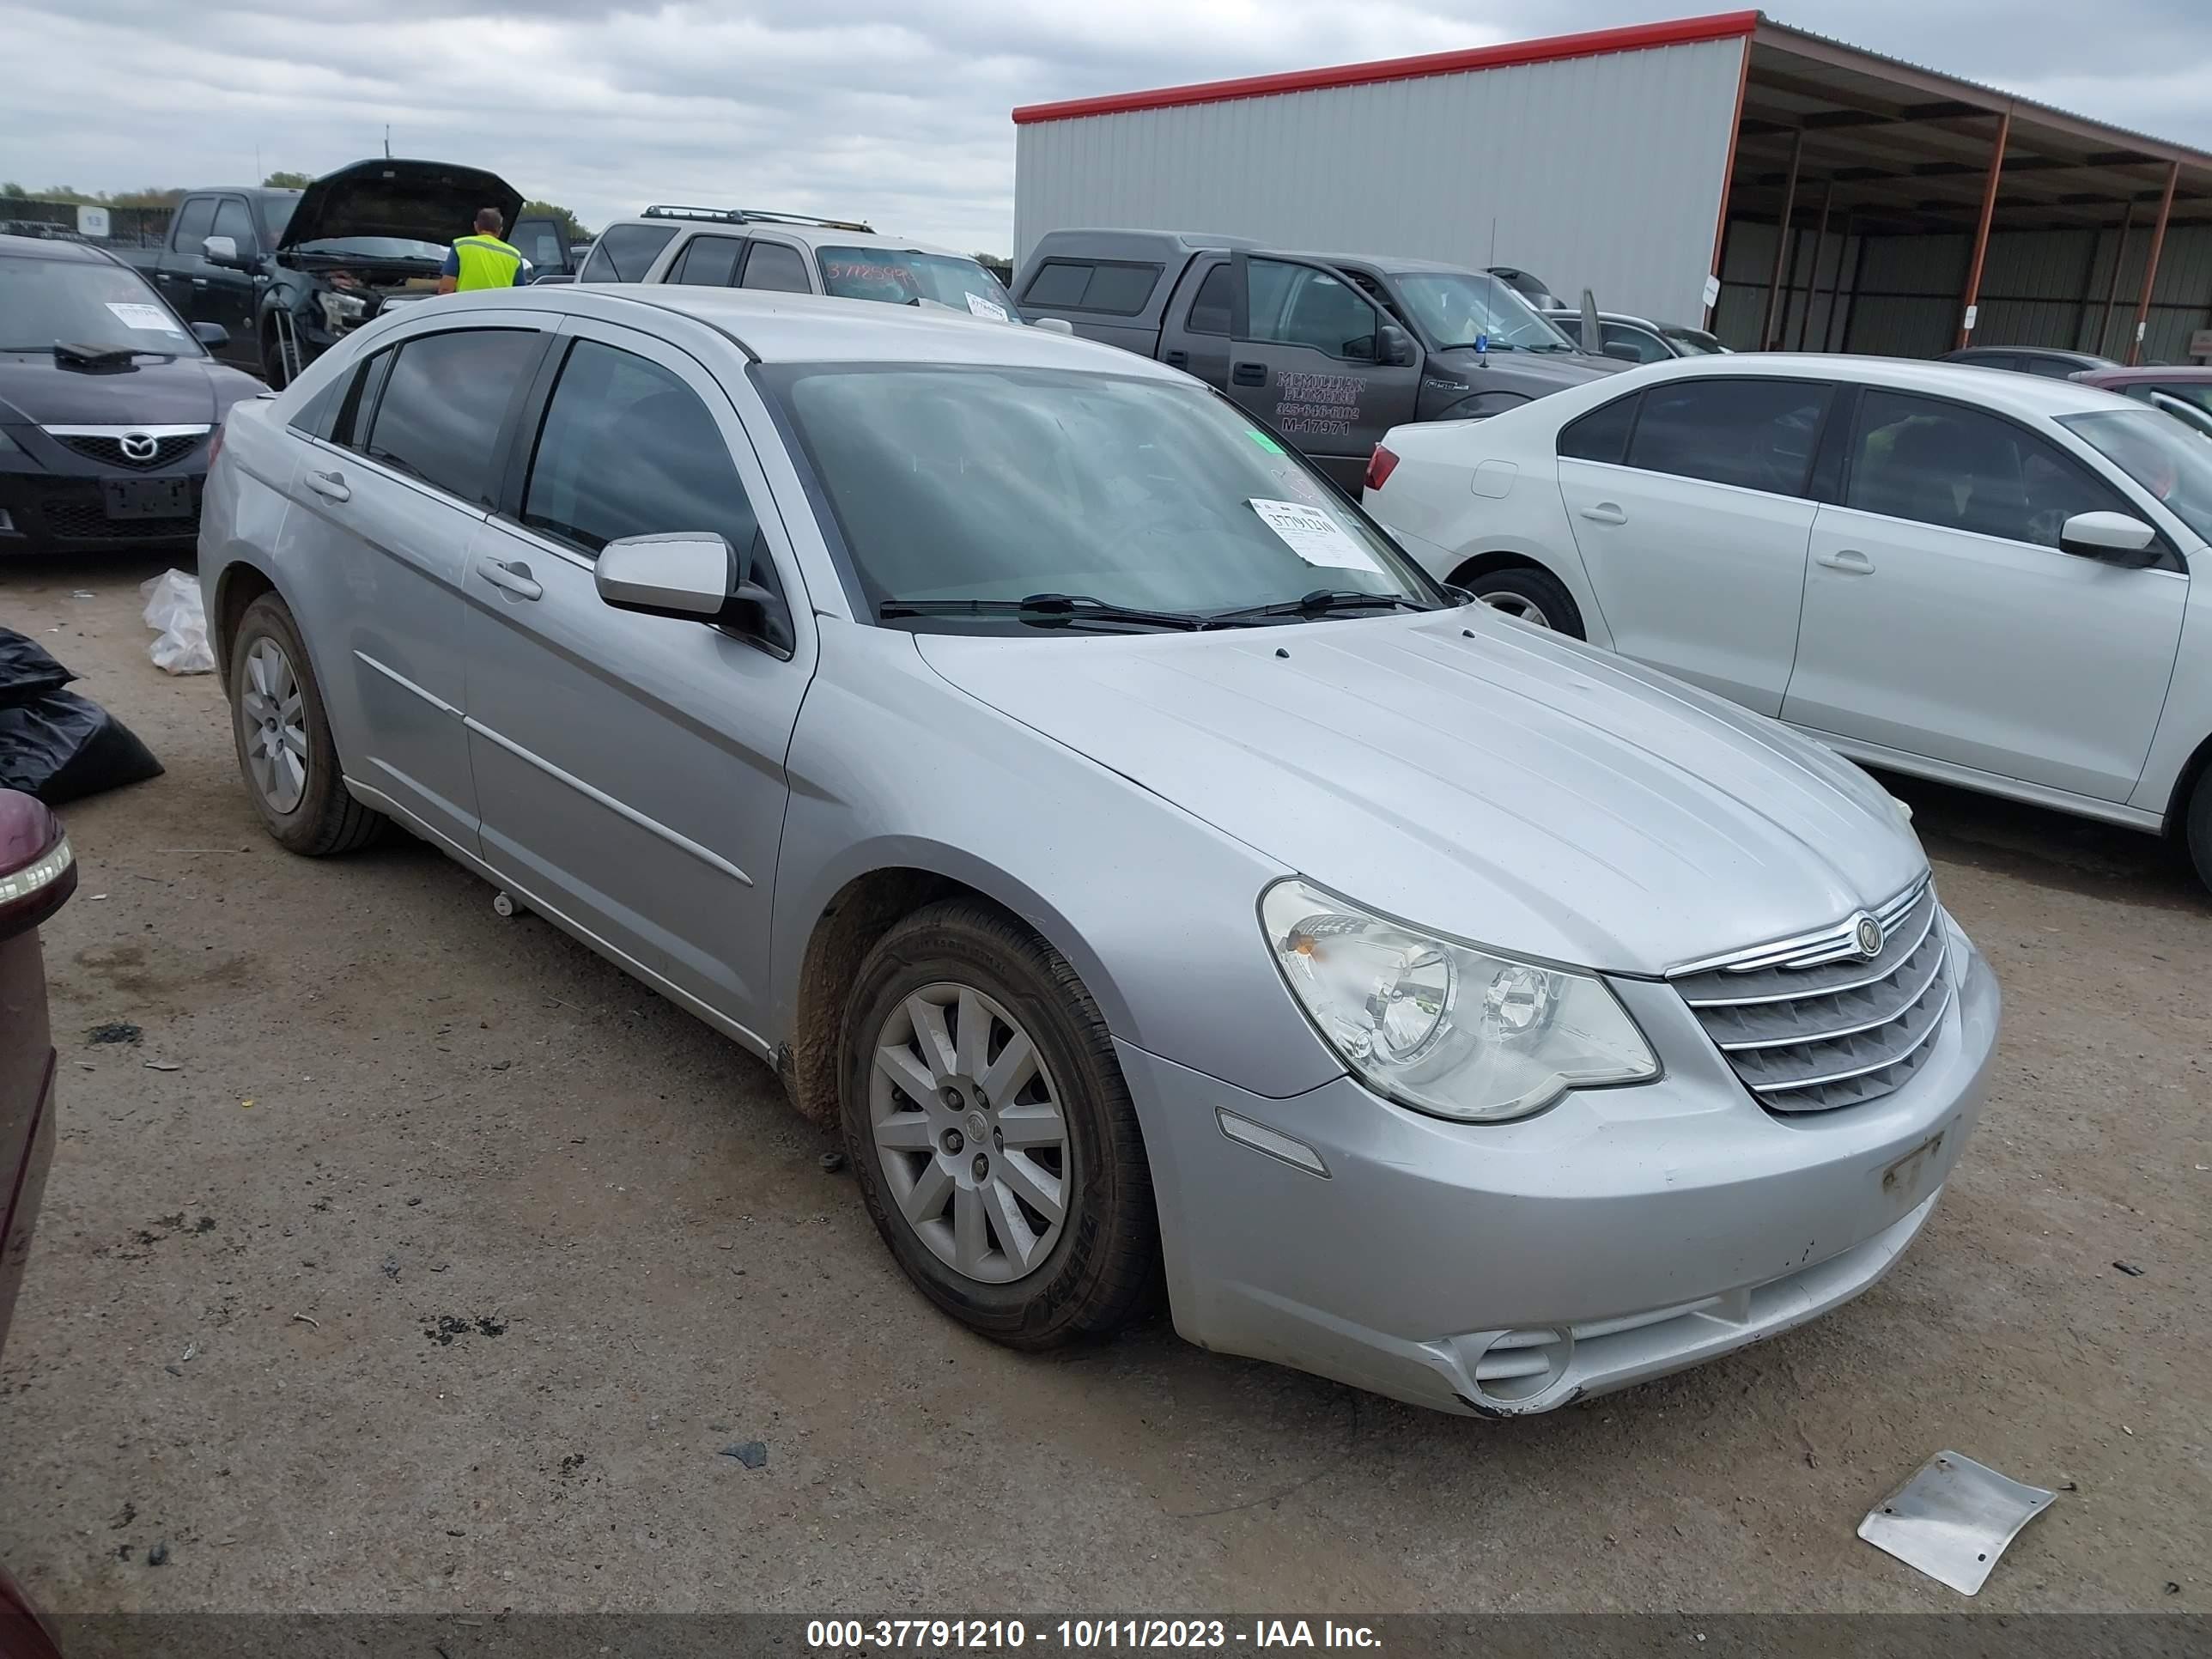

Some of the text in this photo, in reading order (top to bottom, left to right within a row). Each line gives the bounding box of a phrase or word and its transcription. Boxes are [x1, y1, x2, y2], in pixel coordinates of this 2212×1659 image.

[1284, 387, 1357, 404] PLUMBING
[1282, 417, 1350, 435] M-17971
[1268, 514, 1336, 533] 37791210
